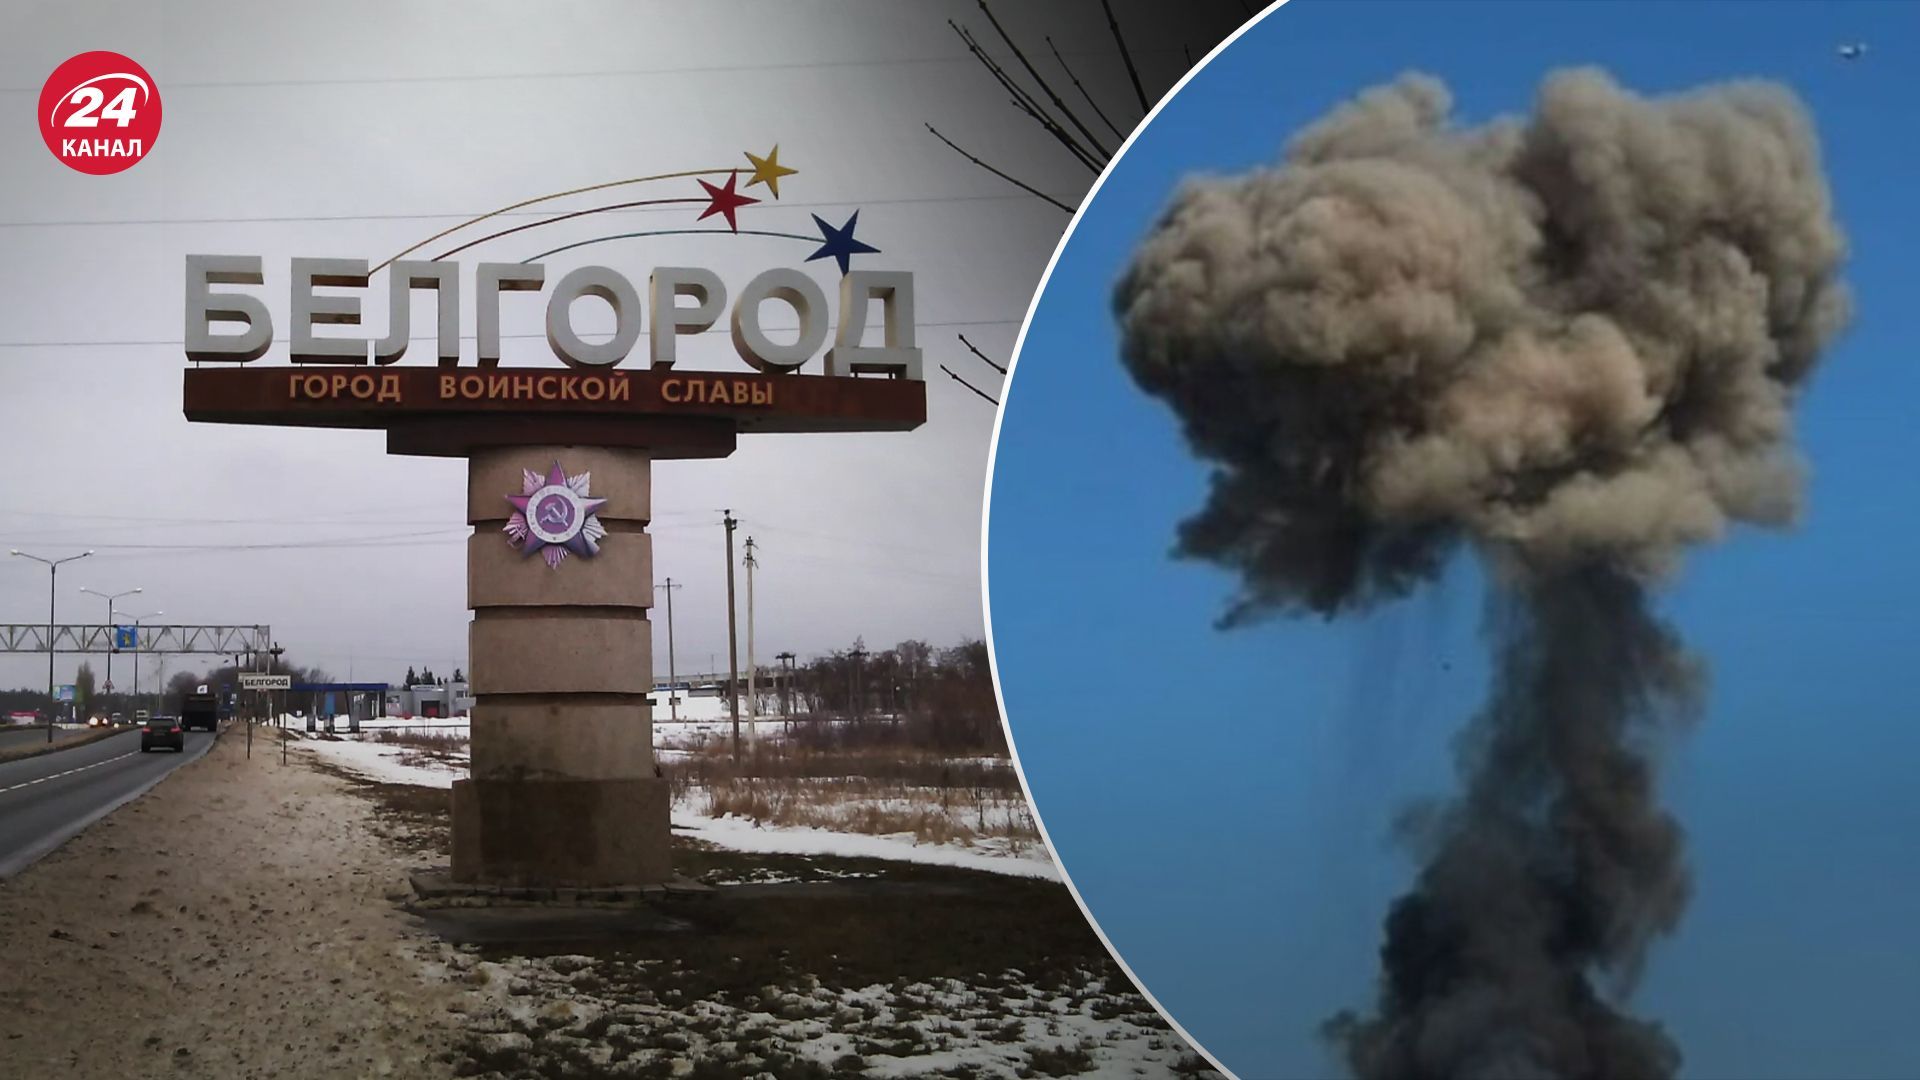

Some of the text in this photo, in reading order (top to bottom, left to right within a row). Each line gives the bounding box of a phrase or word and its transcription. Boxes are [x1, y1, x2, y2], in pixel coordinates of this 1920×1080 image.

[185, 254, 923, 379] БЕЛГОРОД
[289, 371, 774, 405] ГОРОД ВОИНСКОЙ СЛАВЫ
[244, 678, 288, 686] БЕЛГОРОД
